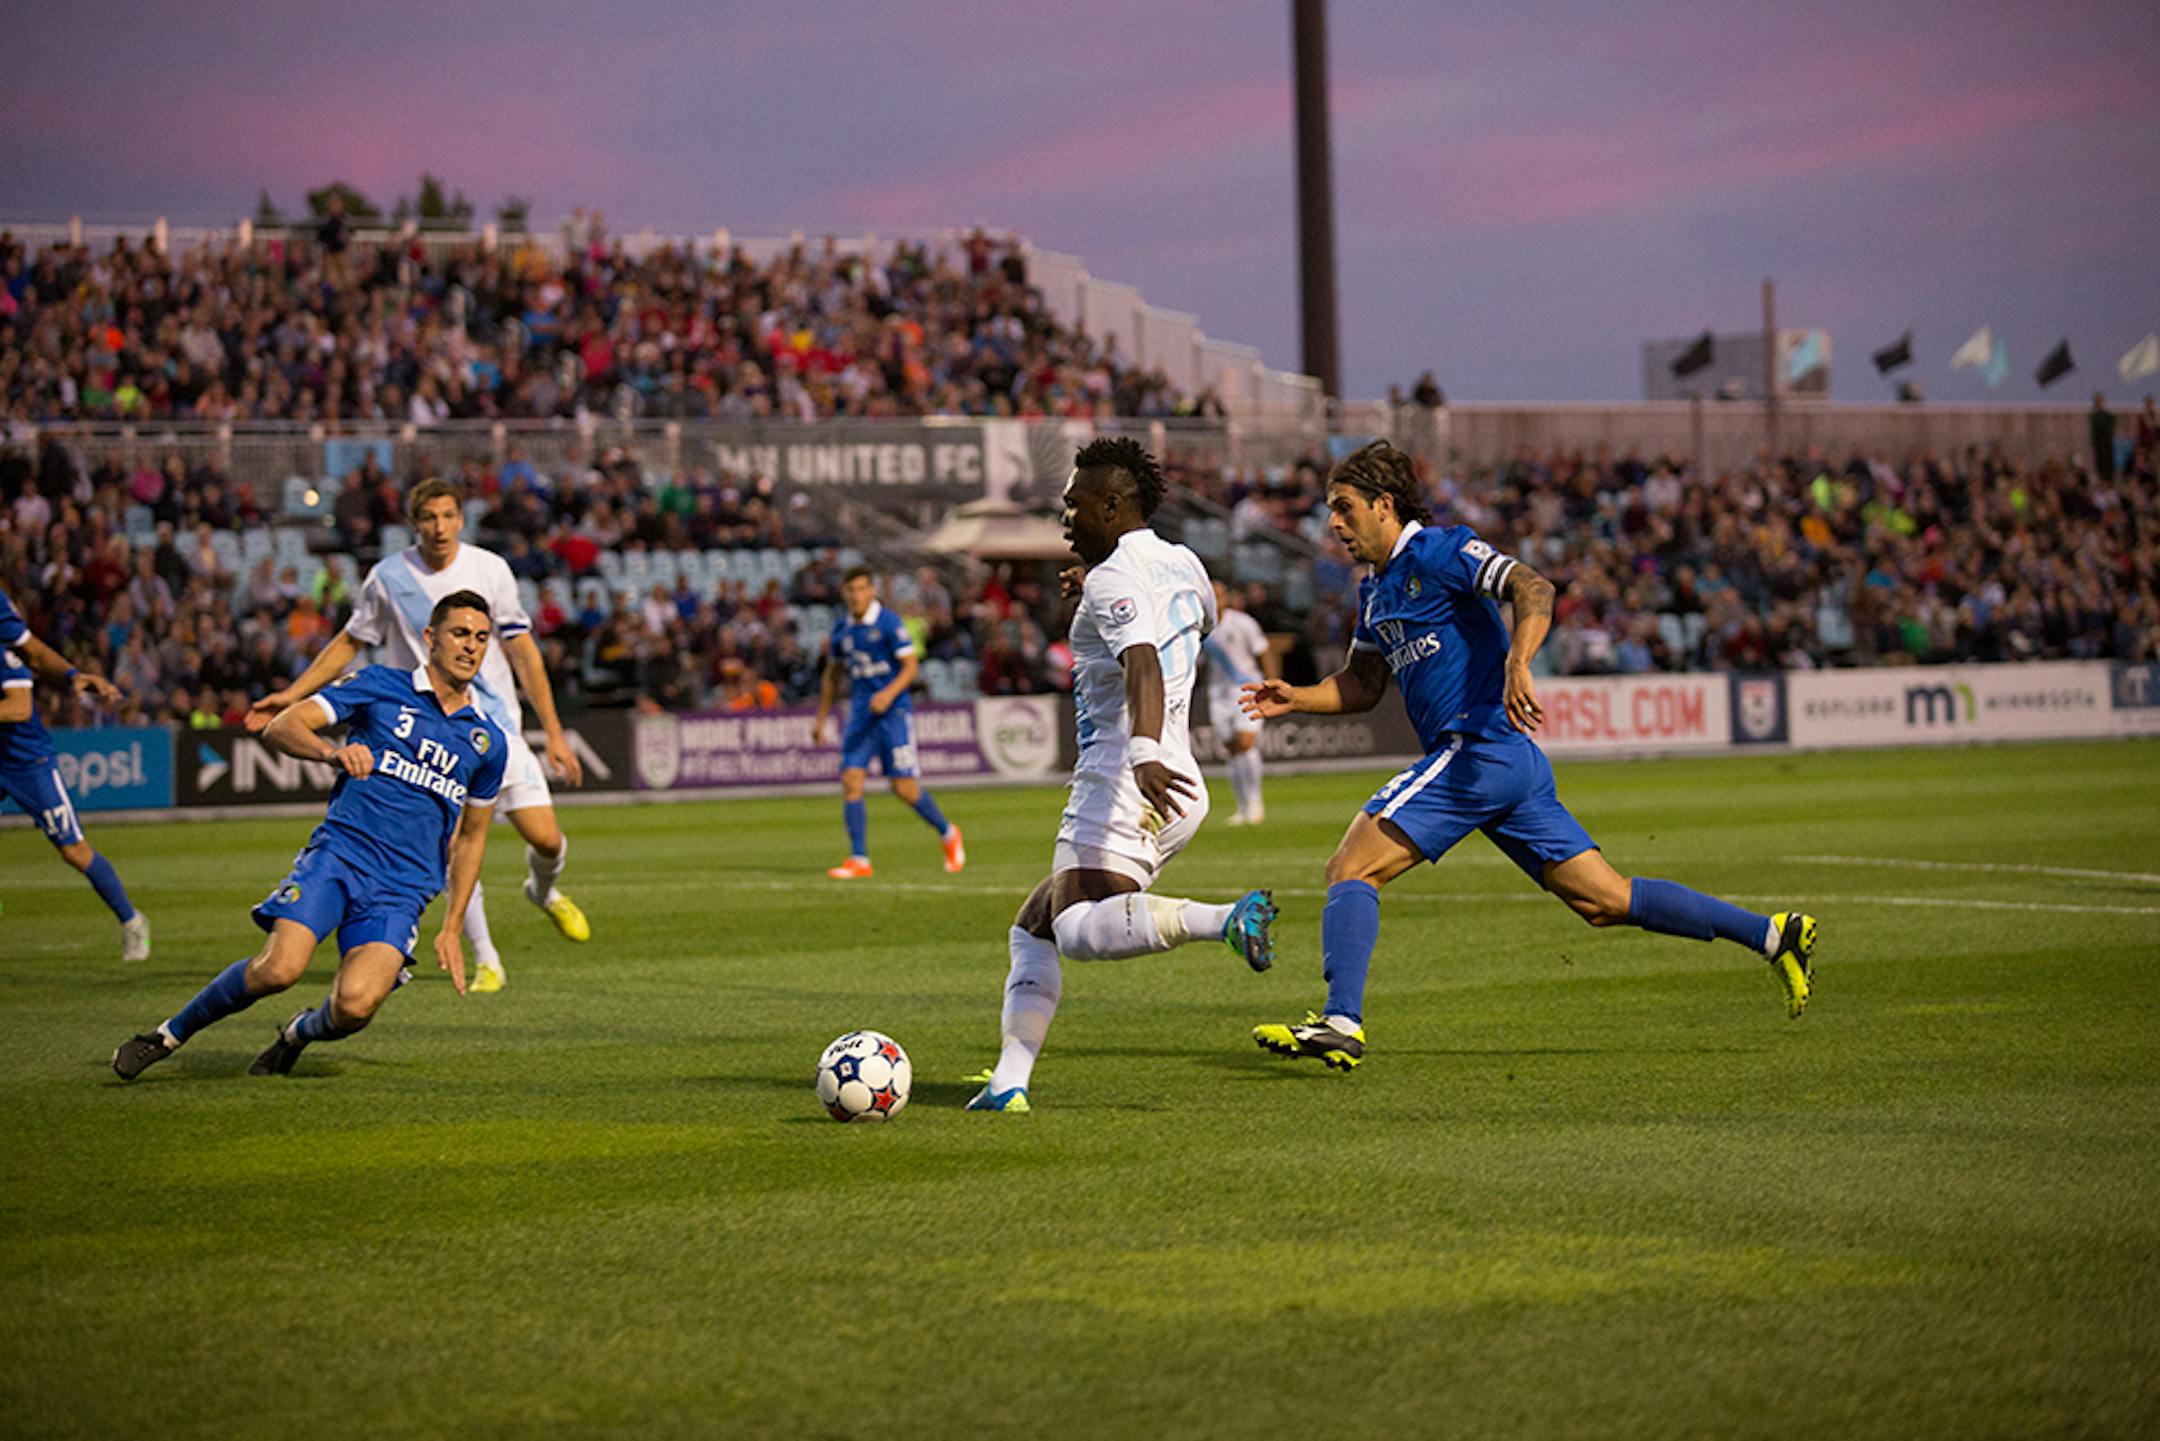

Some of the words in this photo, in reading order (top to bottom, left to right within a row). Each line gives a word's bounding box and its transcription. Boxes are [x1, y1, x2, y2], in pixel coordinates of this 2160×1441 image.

[787, 445, 926, 485] UNITED
[933, 444, 981, 483] FC
[393, 713, 415, 739] 3
[57, 741, 143, 797] epsi
[417, 737, 460, 775] Fly
[379, 749, 467, 806] Emirate
[43, 804, 71, 836] 17
